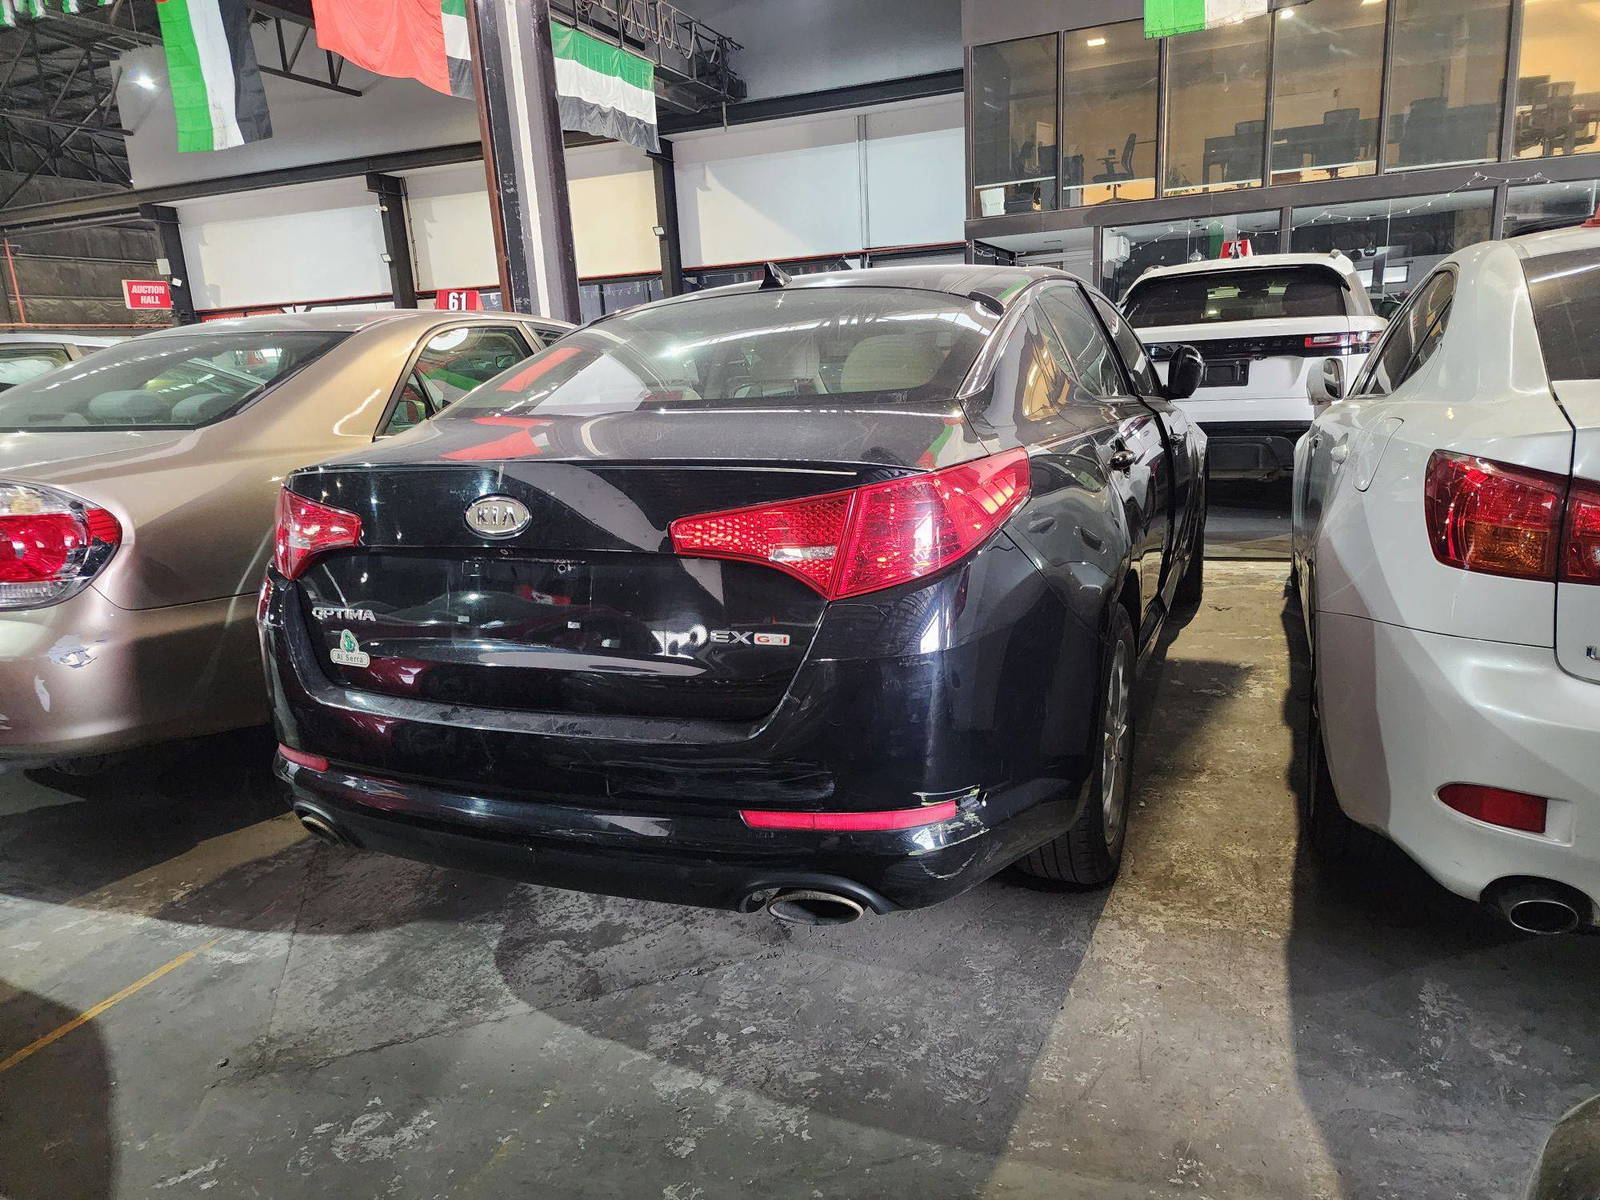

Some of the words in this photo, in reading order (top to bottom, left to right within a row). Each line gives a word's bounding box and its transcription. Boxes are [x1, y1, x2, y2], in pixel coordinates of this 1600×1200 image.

[131, 285, 165, 294] AUCTION
[140, 295, 160, 304] HALL
[448, 291, 467, 310] 61
[475, 505, 517, 527] KIA
[311, 606, 377, 622] OPTIMA
[709, 630, 753, 645] EX
